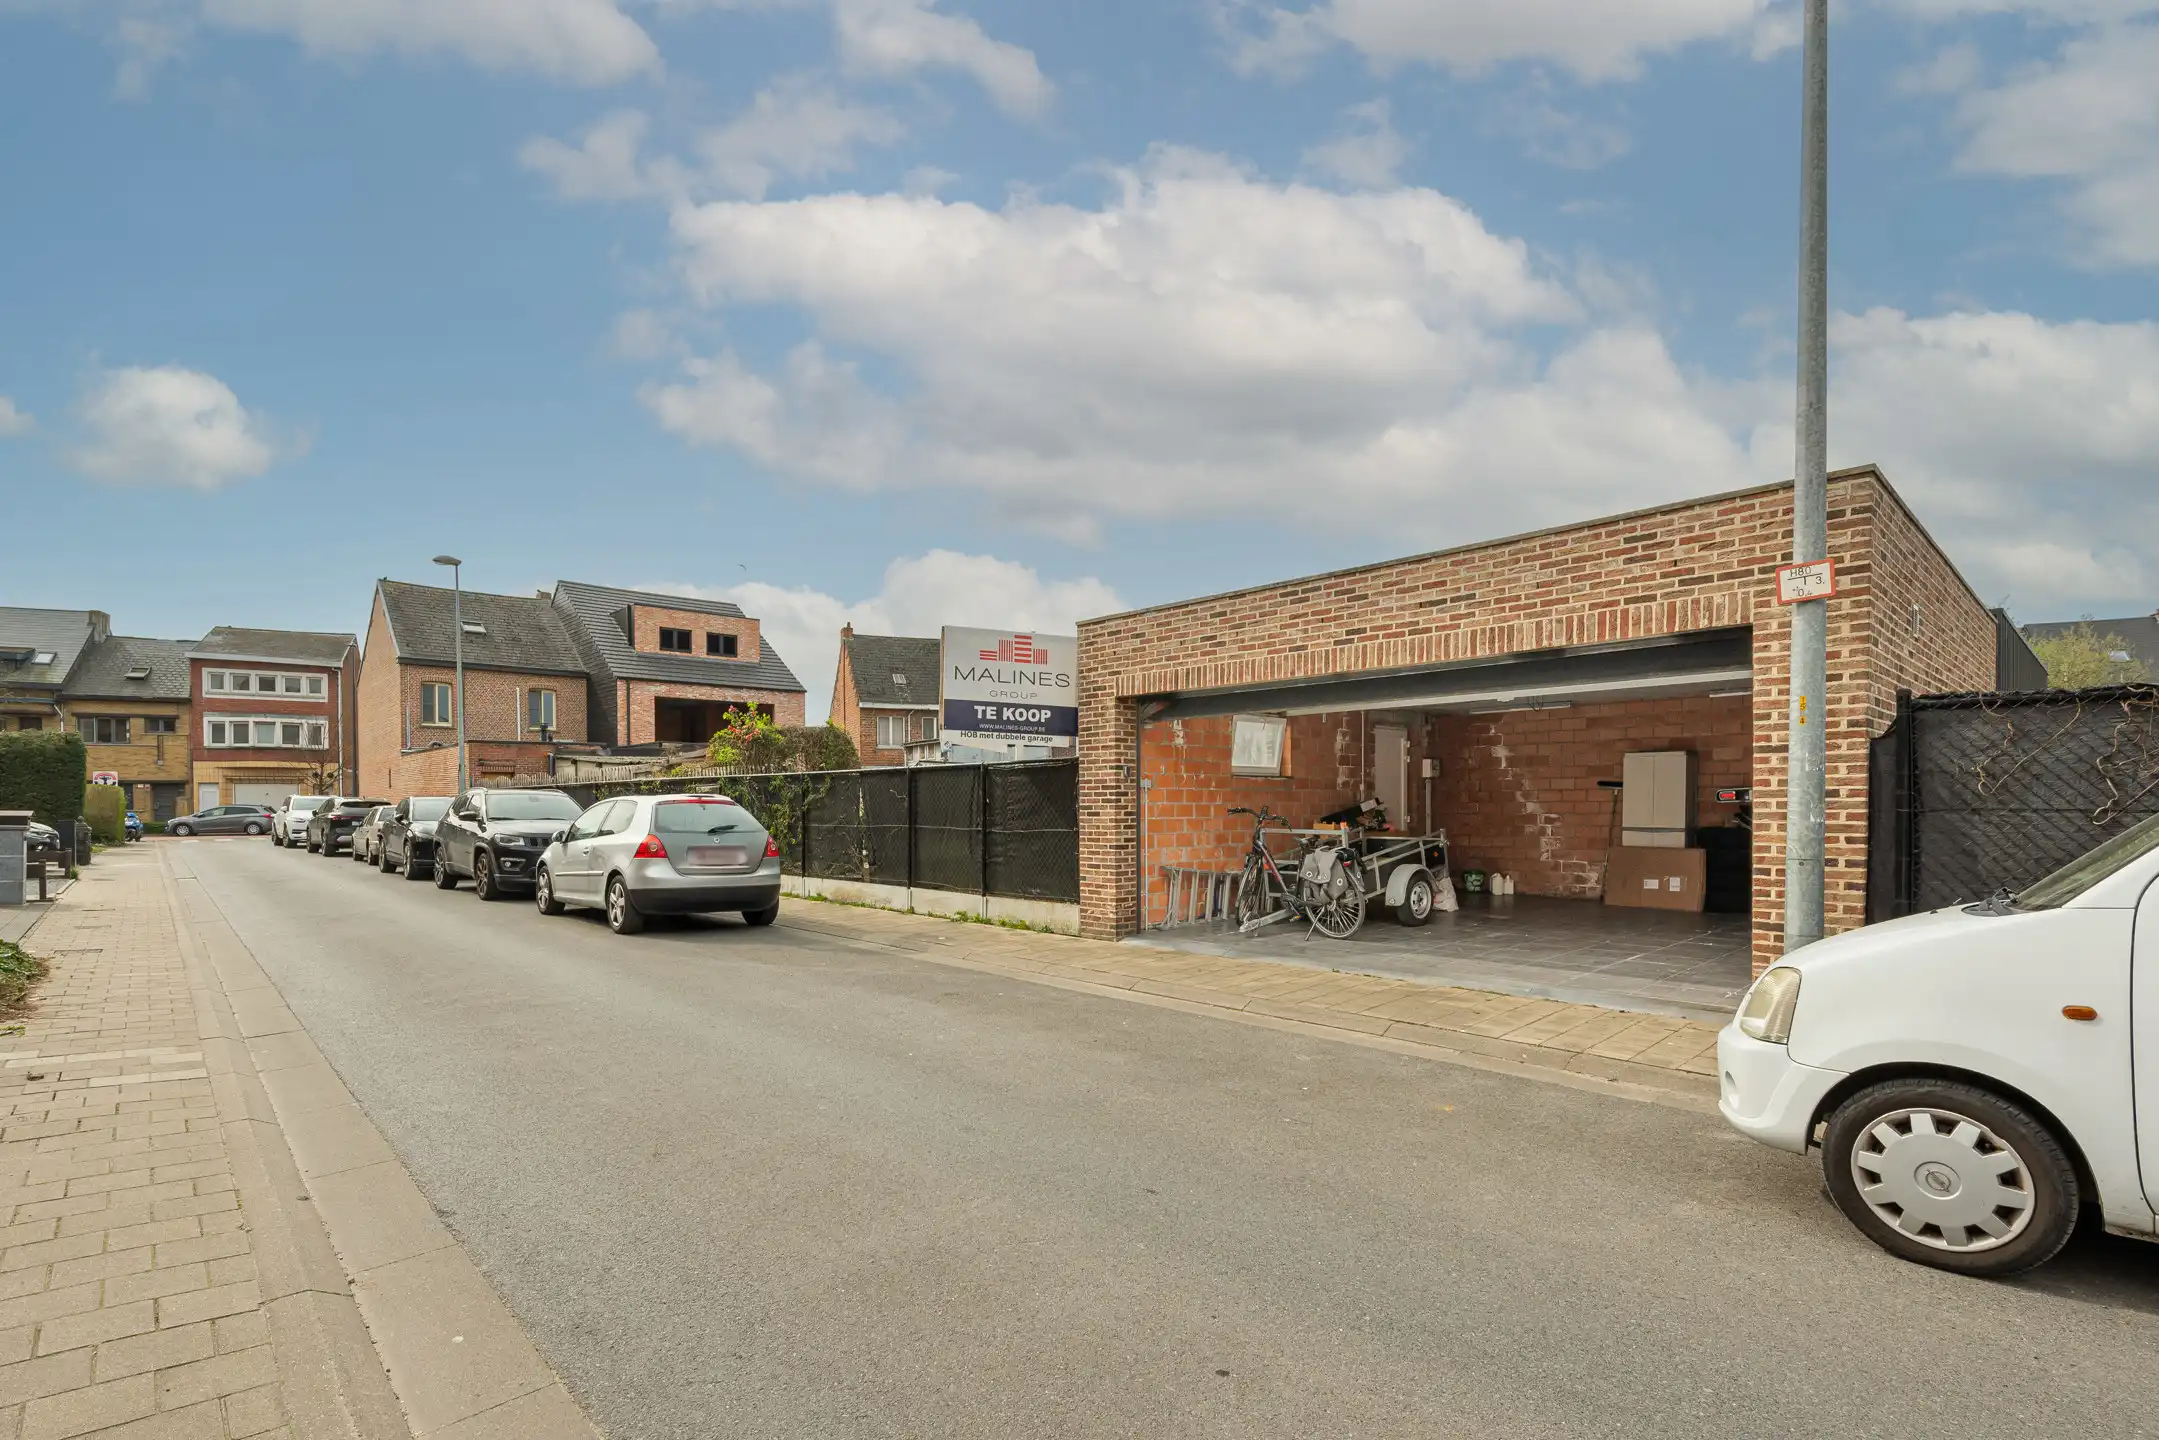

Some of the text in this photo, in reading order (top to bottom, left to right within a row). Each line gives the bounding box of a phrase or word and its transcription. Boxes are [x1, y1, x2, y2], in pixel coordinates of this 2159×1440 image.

[954, 665, 1070, 687] MALINES
[989, 690, 1038, 699] GROUP
[973, 705, 1052, 722] TE KOOP
[995, 732, 1027, 741] dubbele
[1027, 735, 1053, 743] garage
